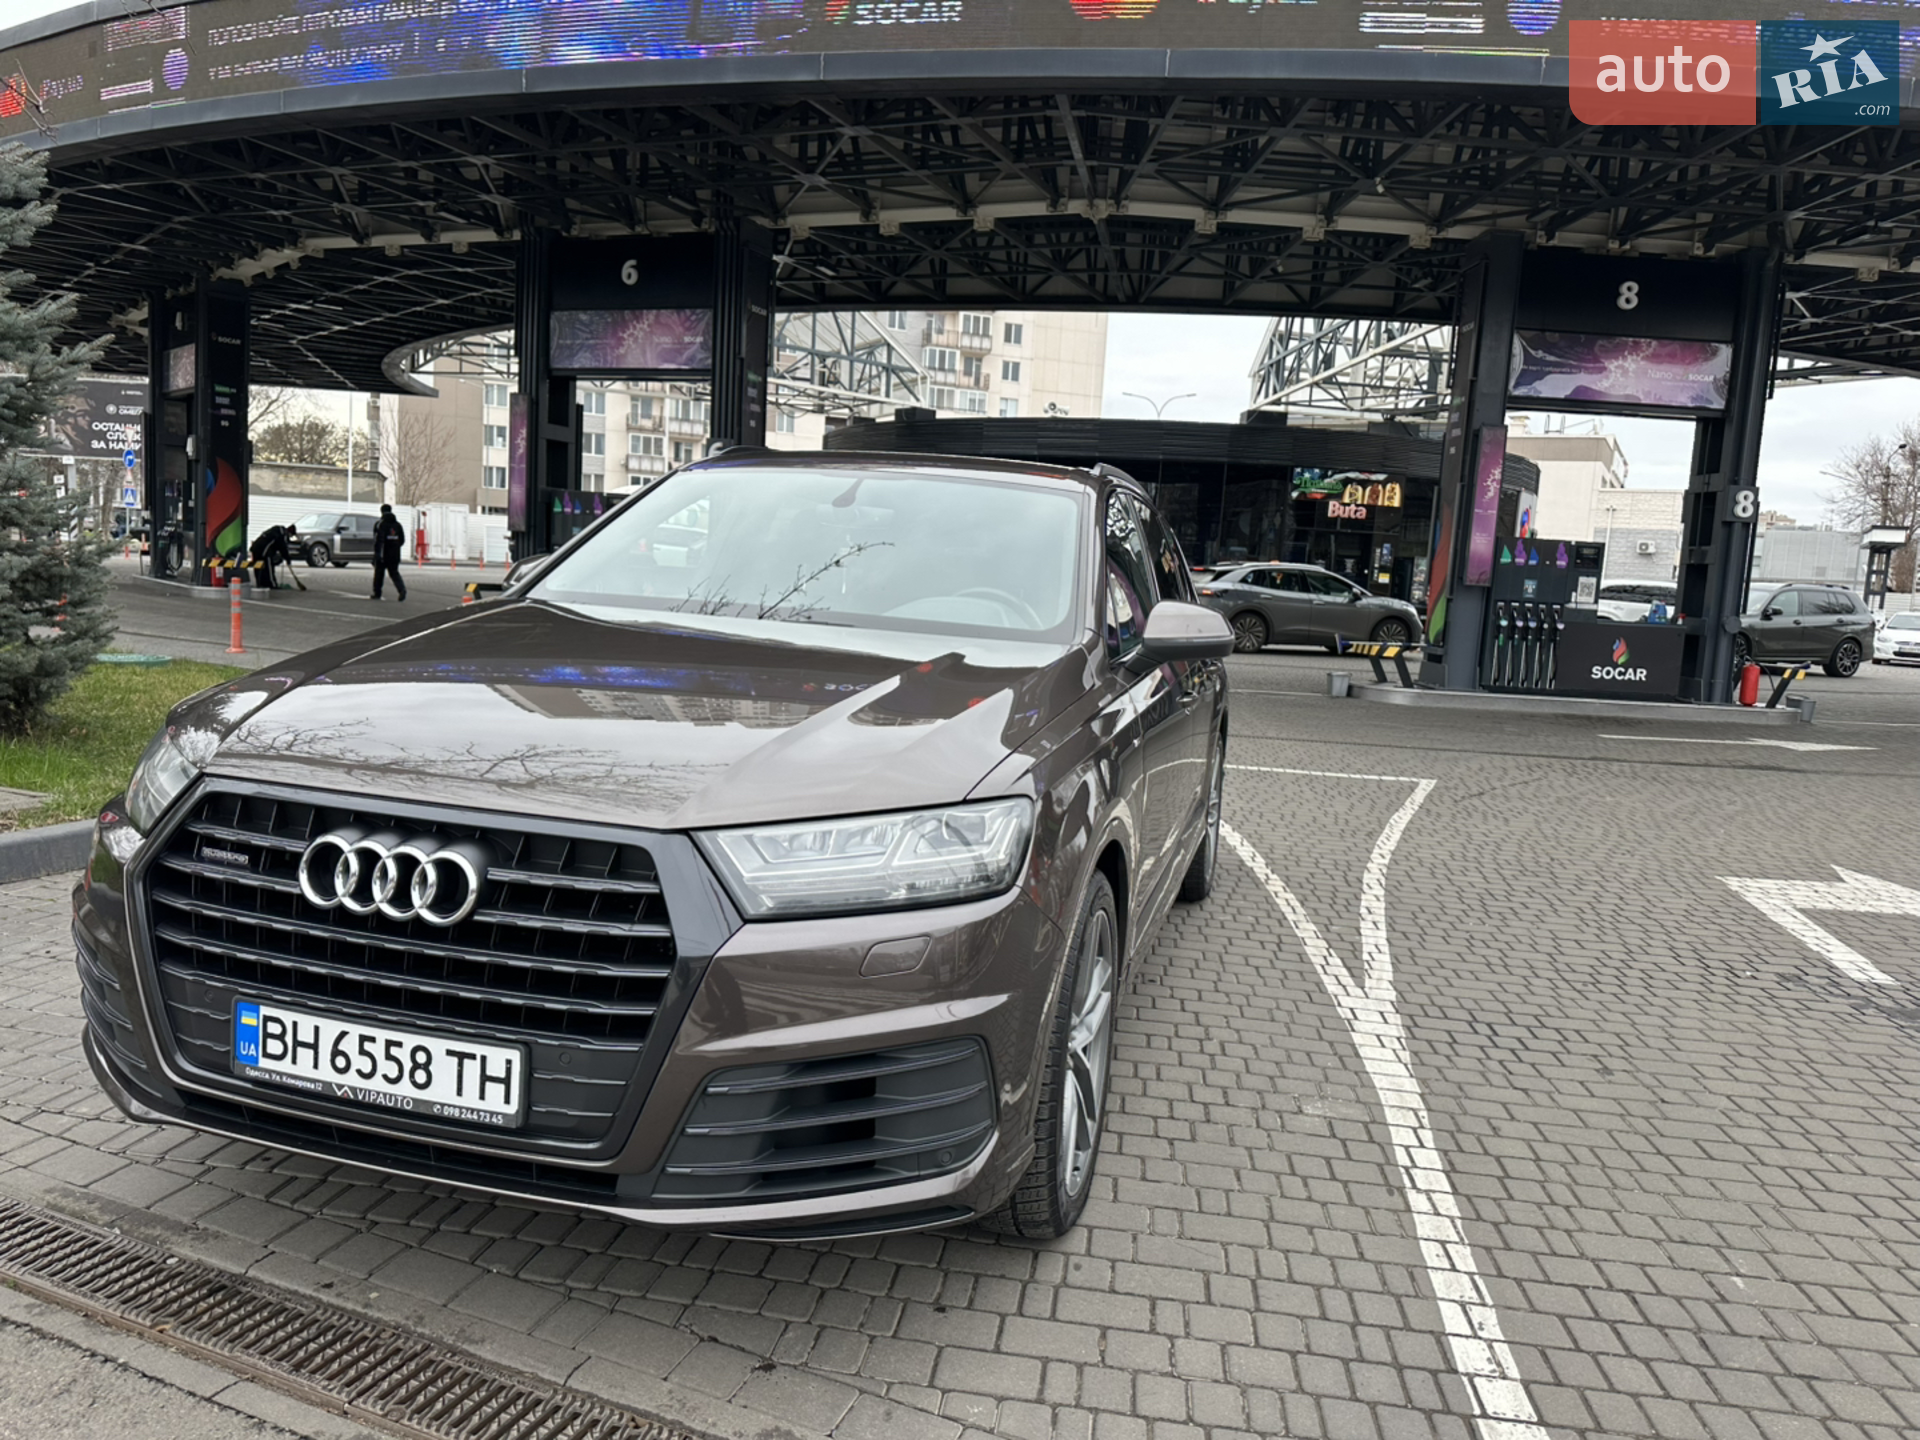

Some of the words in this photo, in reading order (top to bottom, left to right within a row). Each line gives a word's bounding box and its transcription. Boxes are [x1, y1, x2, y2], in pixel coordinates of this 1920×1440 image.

[852, 1, 962, 25] SOCAR
[621, 259, 639, 285] 6
[1616, 280, 1640, 310] 8
[1688, 373, 1715, 382] SOCAR
[1328, 500, 1367, 519] Buta
[1733, 490, 1754, 518] 8
[1590, 666, 1647, 681] SOCAR
[240, 1041, 257, 1057] UA
[261, 1014, 320, 1070] BH
[329, 1030, 433, 1091] 6558
[445, 1048, 513, 1105] TH
[356, 1088, 413, 1110] VIPAUTO
